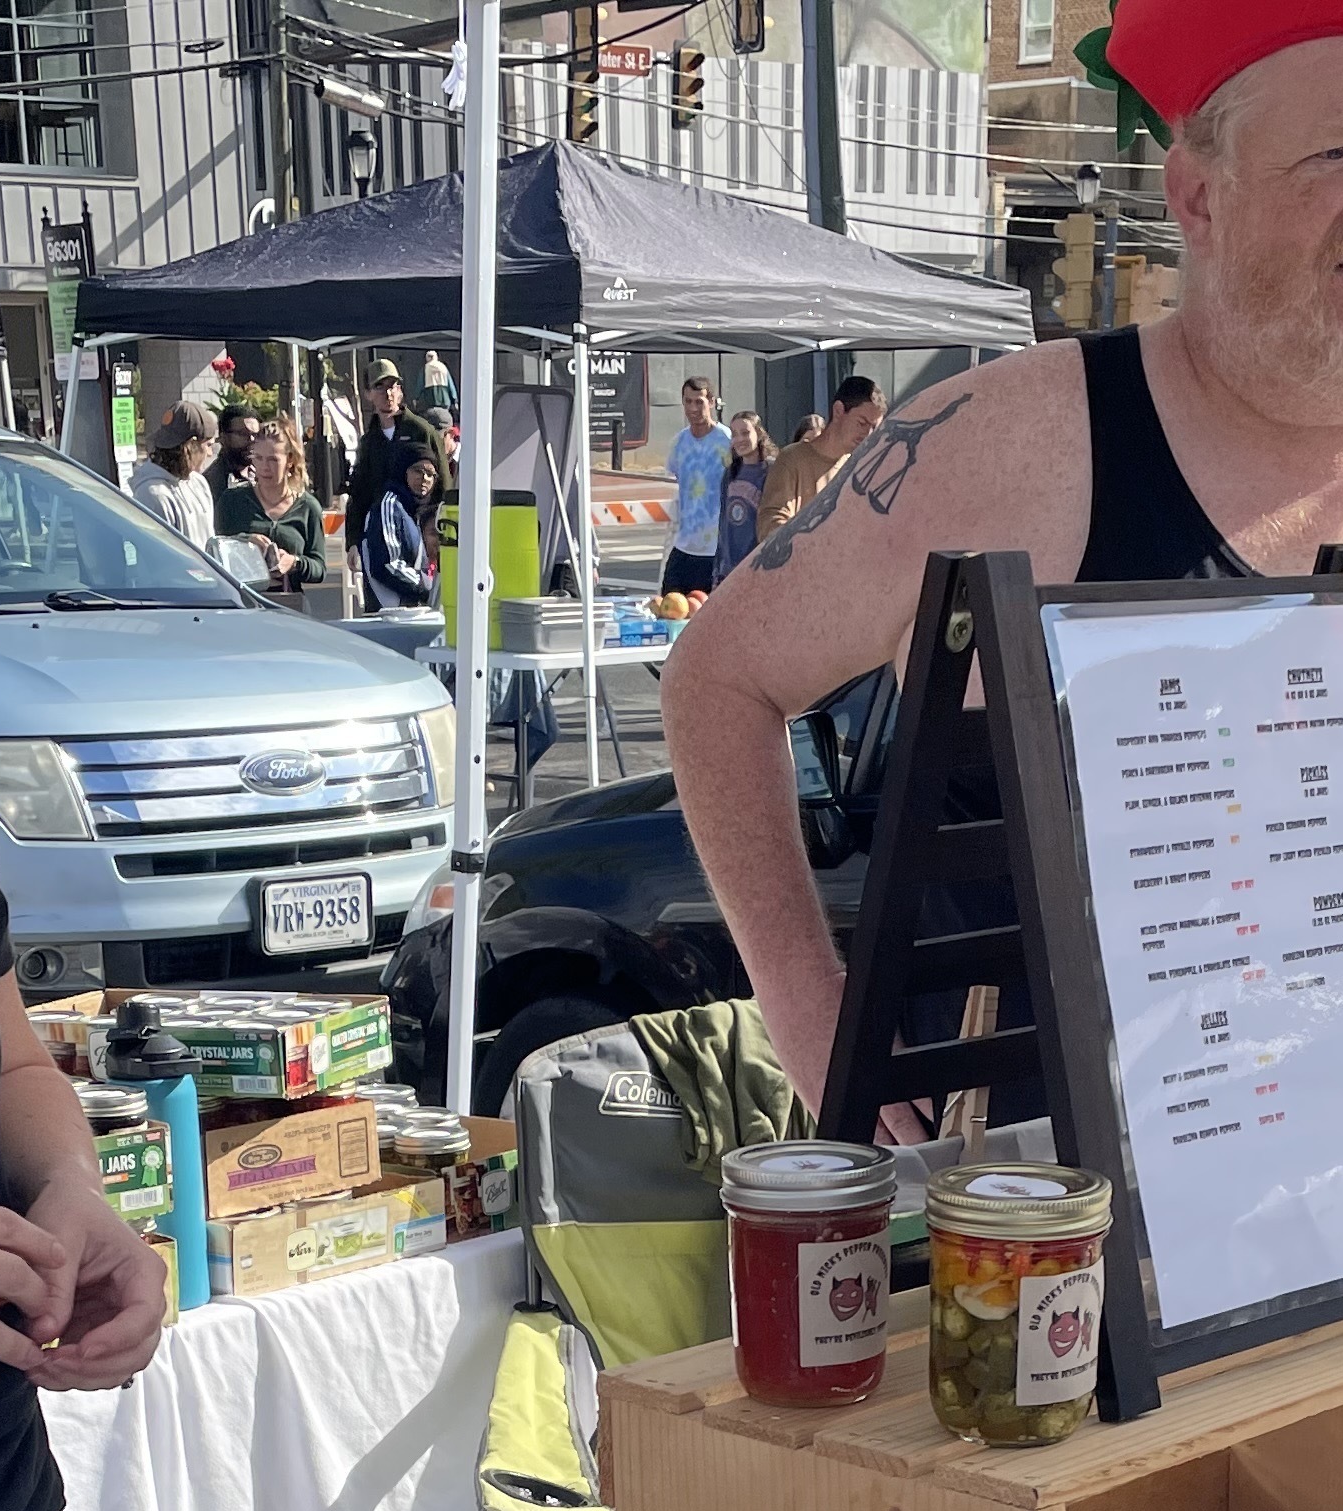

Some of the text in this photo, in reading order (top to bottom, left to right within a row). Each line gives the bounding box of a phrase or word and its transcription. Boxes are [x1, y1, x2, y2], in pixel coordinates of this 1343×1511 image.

[624, 52, 635, 69] St
[638, 53, 645, 70] E
[47, 239, 82, 263] 96301
[603, 287, 637, 301] QUEST
[590, 358, 625, 375] MAIN
[268, 758, 309, 779] Ford
[292, 884, 339, 898] VIRGINIA
[272, 896, 361, 933] VRW-9358
[231, 1047, 254, 1060] JARS
[614, 1076, 682, 1107] Colema
[106, 1153, 136, 1173] JARS
[485, 1179, 507, 1203] Ball
[810, 1280, 822, 1296] OLD
[843, 1242, 872, 1257] PEPPER
[1029, 1314, 1041, 1331] OLD
